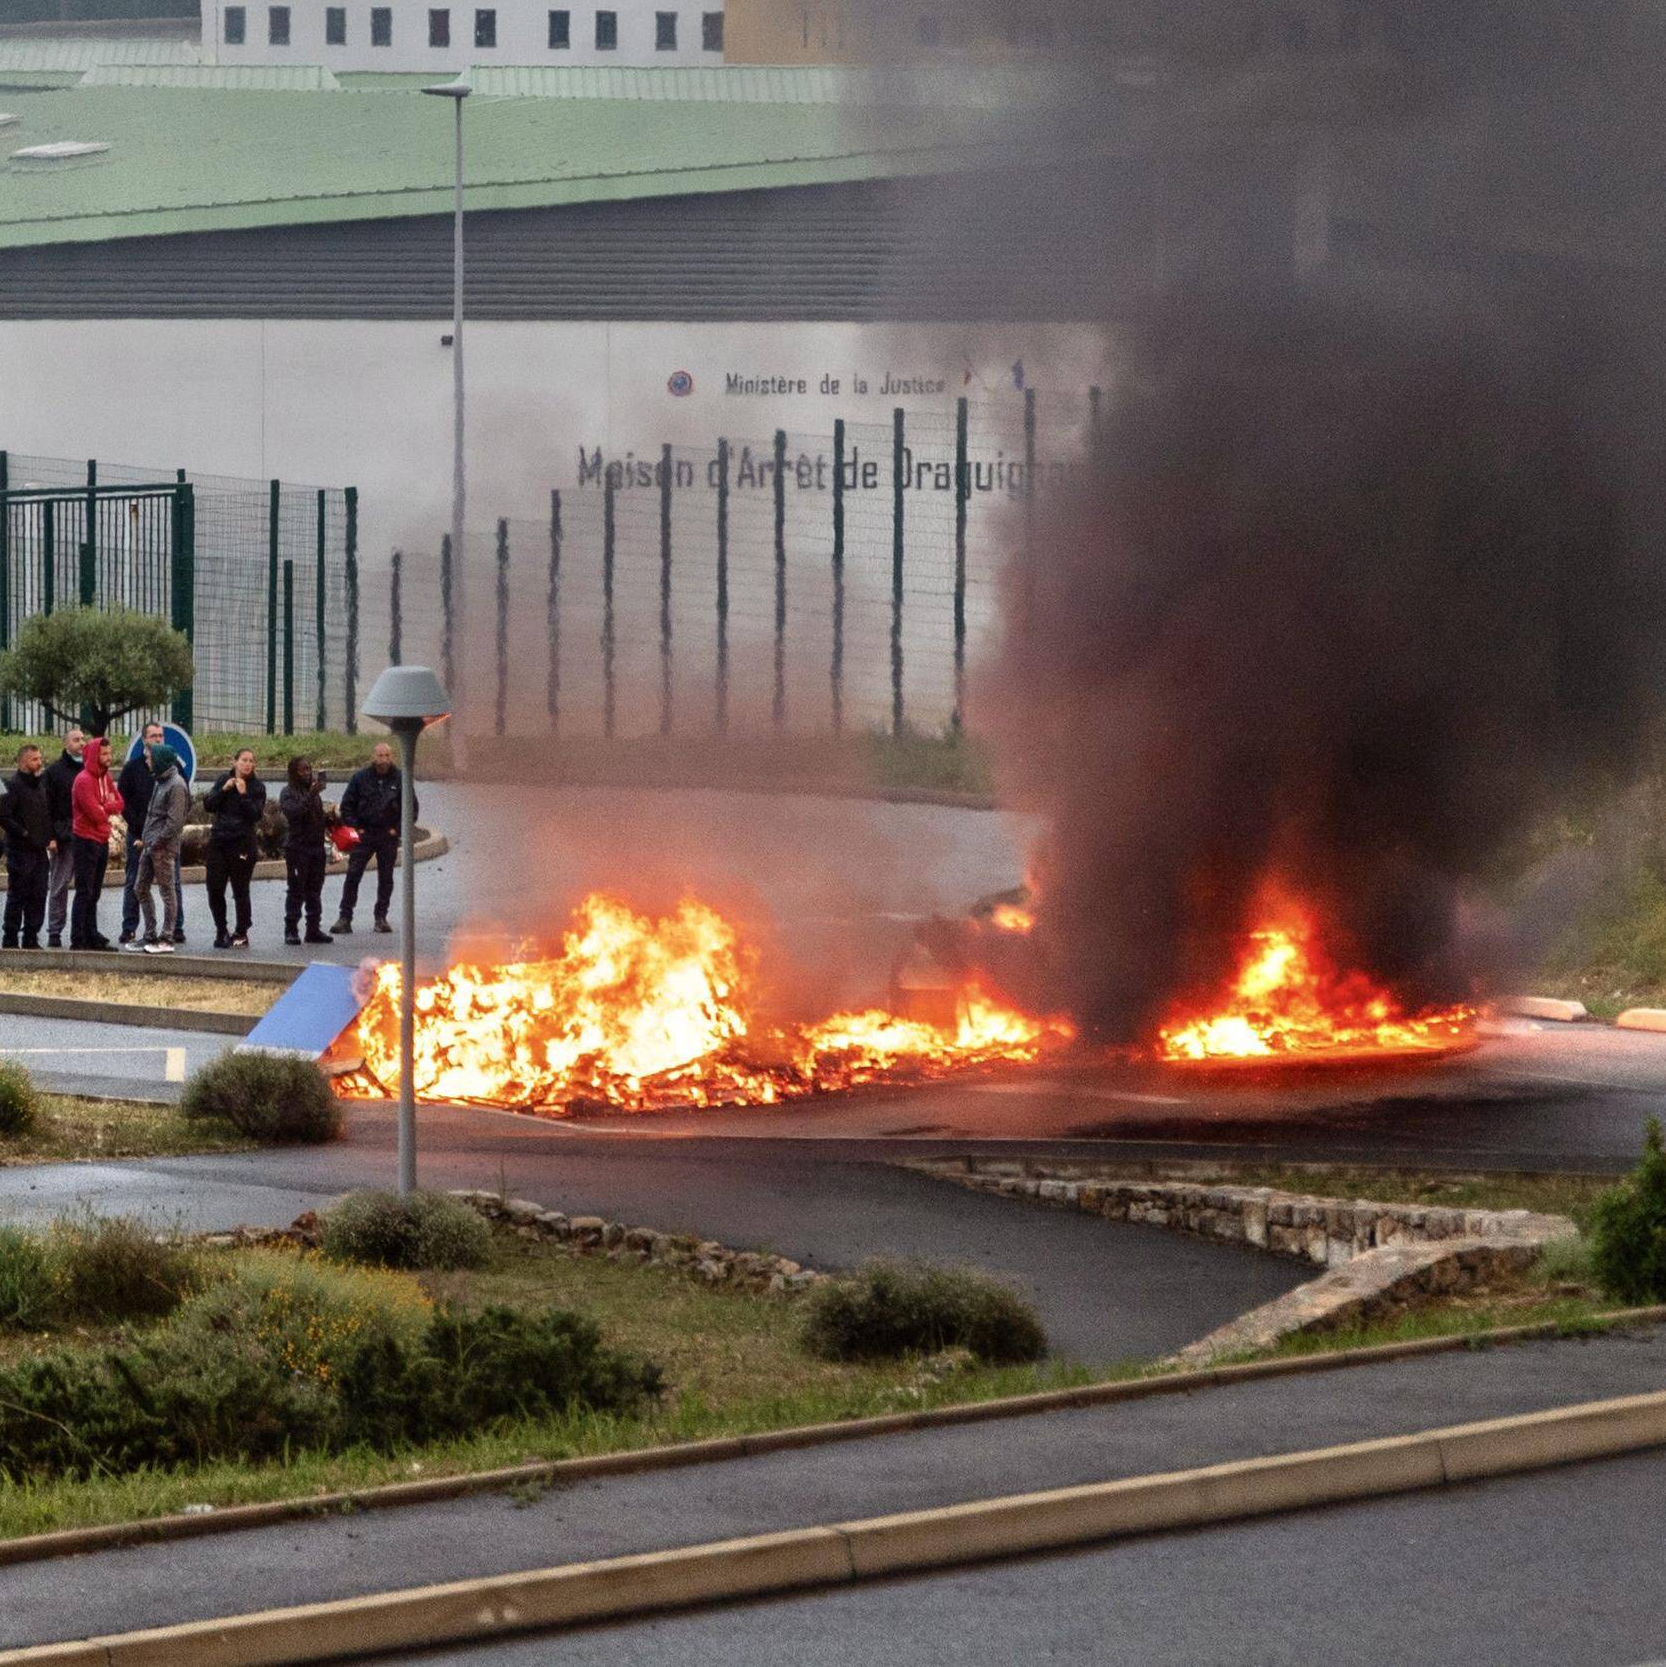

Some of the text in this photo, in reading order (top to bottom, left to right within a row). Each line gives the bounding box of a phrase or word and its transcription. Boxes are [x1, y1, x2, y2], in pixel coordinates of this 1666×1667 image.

[725, 372, 945, 395] Ministère de la Justice
[842, 445, 878, 490] de
[899, 446, 1079, 500] Drauig
